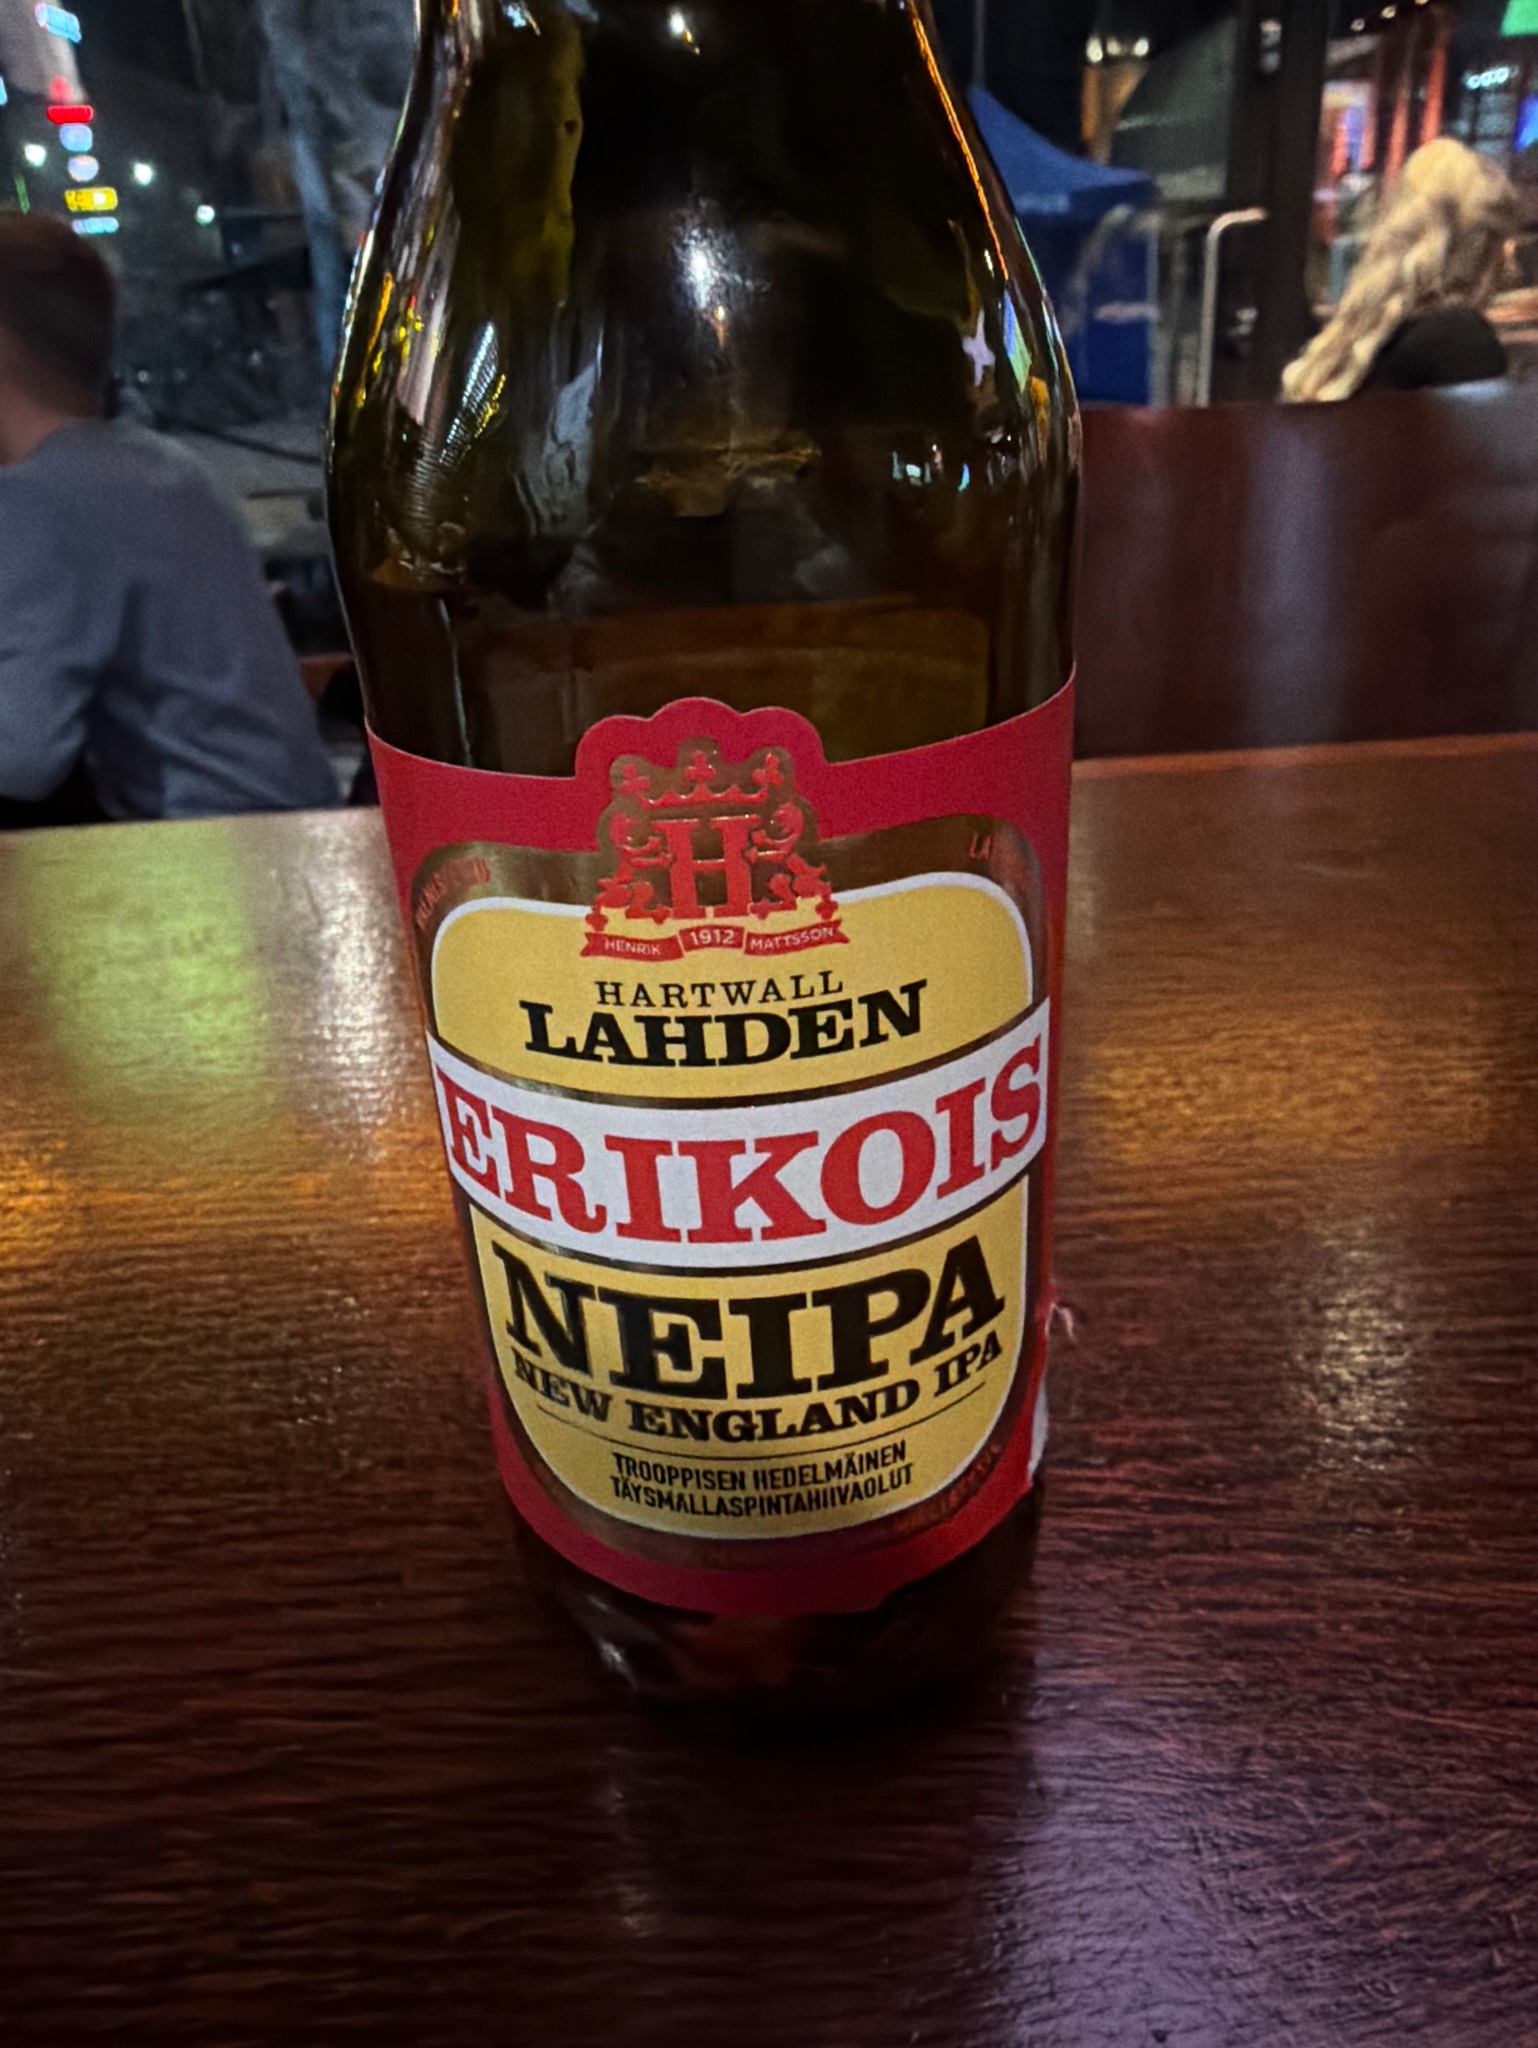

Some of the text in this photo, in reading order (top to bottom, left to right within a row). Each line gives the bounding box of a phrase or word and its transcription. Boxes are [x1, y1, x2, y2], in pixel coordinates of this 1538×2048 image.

[652, 813, 761, 919] H
[604, 927, 835, 956] HENRIK 1912 MATTSSON
[518, 978, 929, 1068] LAHDEN
[594, 969, 844, 1009] HARTWALL
[434, 1033, 1044, 1245] ERIKOIS
[492, 1234, 1006, 1401] NEIPA
[513, 1329, 1003, 1443] NEW ENGLAND IPA
[609, 1463, 914, 1518] TÄYSMALLASPINTAHIIVAOLUT
[611, 1451, 746, 1491] TROOPPISEN
[752, 1438, 907, 1491] HEDELMÄINEN
